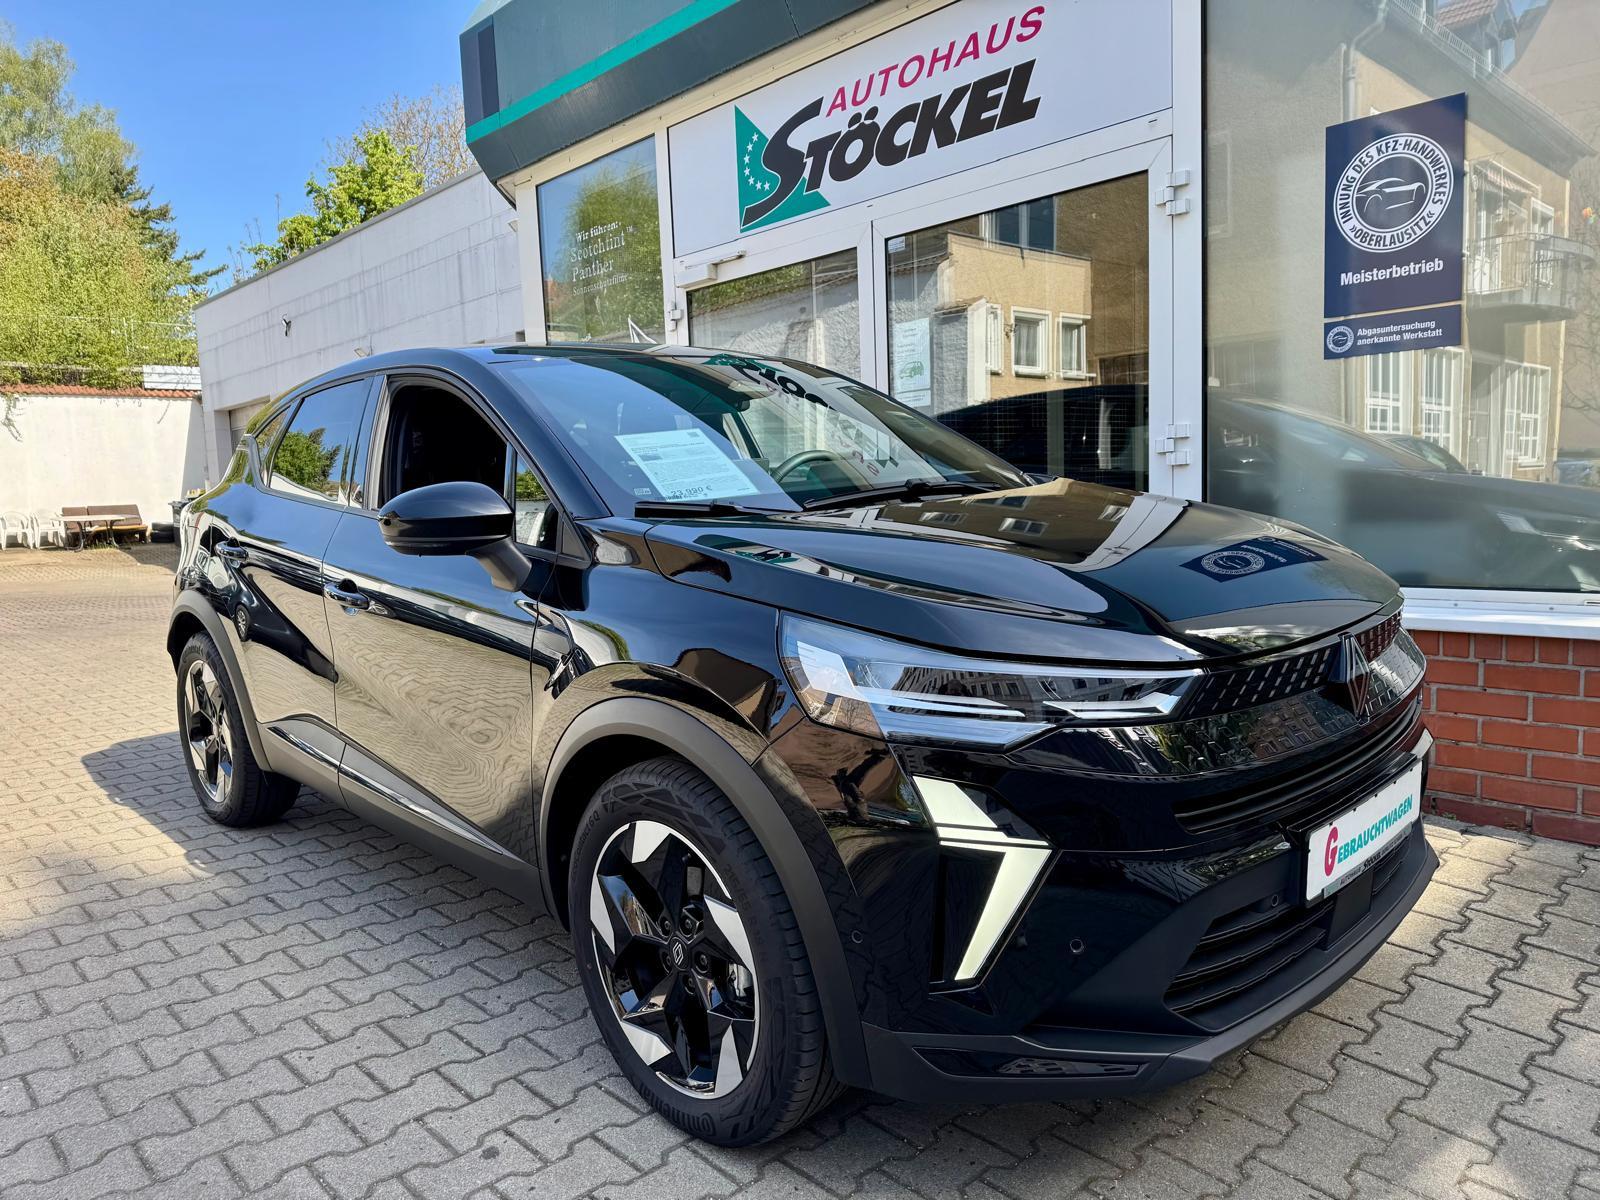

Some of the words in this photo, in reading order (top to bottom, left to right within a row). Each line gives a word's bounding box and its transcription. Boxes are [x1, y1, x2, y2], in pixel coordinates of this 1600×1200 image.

[825, 5, 1045, 118] AUTOHAUS
[741, 58, 1041, 228] STÖCKEL
[1339, 175, 1357, 224] INNUNG
[1352, 151, 1374, 174] DES
[1376, 138, 1448, 205] KFZ-HANDWERKES
[570, 230, 626, 262] Scotchtint
[572, 259, 614, 282] Panther
[1340, 257, 1444, 286] Meisterbetrieb
[1357, 320, 1436, 337] Abgasuntersuchung
[1357, 333, 1401, 345] anerkannte
[1403, 328, 1443, 341] Werkstatt
[1324, 794, 1413, 877] GEBRAUCHTWAGEN
